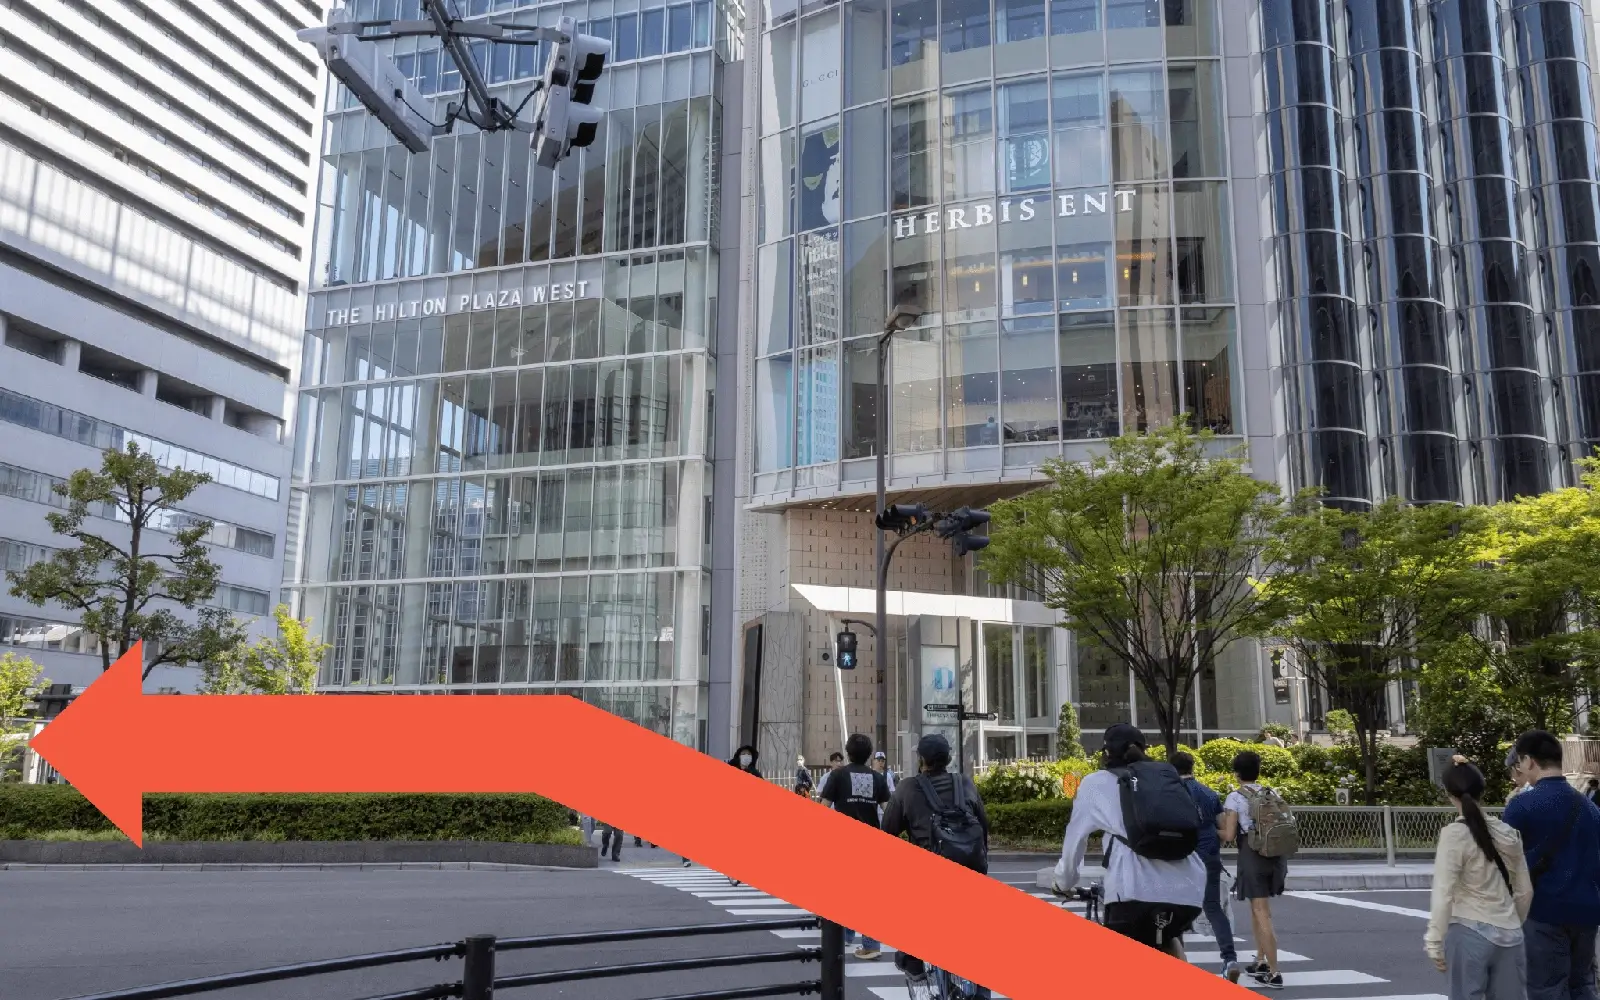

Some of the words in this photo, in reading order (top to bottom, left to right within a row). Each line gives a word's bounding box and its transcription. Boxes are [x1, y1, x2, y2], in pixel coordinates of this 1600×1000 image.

[802, 69, 838, 88] GCCI
[894, 198, 1035, 240] HERBIS
[1058, 189, 1137, 217] ENT
[327, 307, 360, 326] THE
[376, 297, 447, 321] HILTON
[459, 289, 522, 312] PLAZA
[533, 280, 589, 303] WEST
